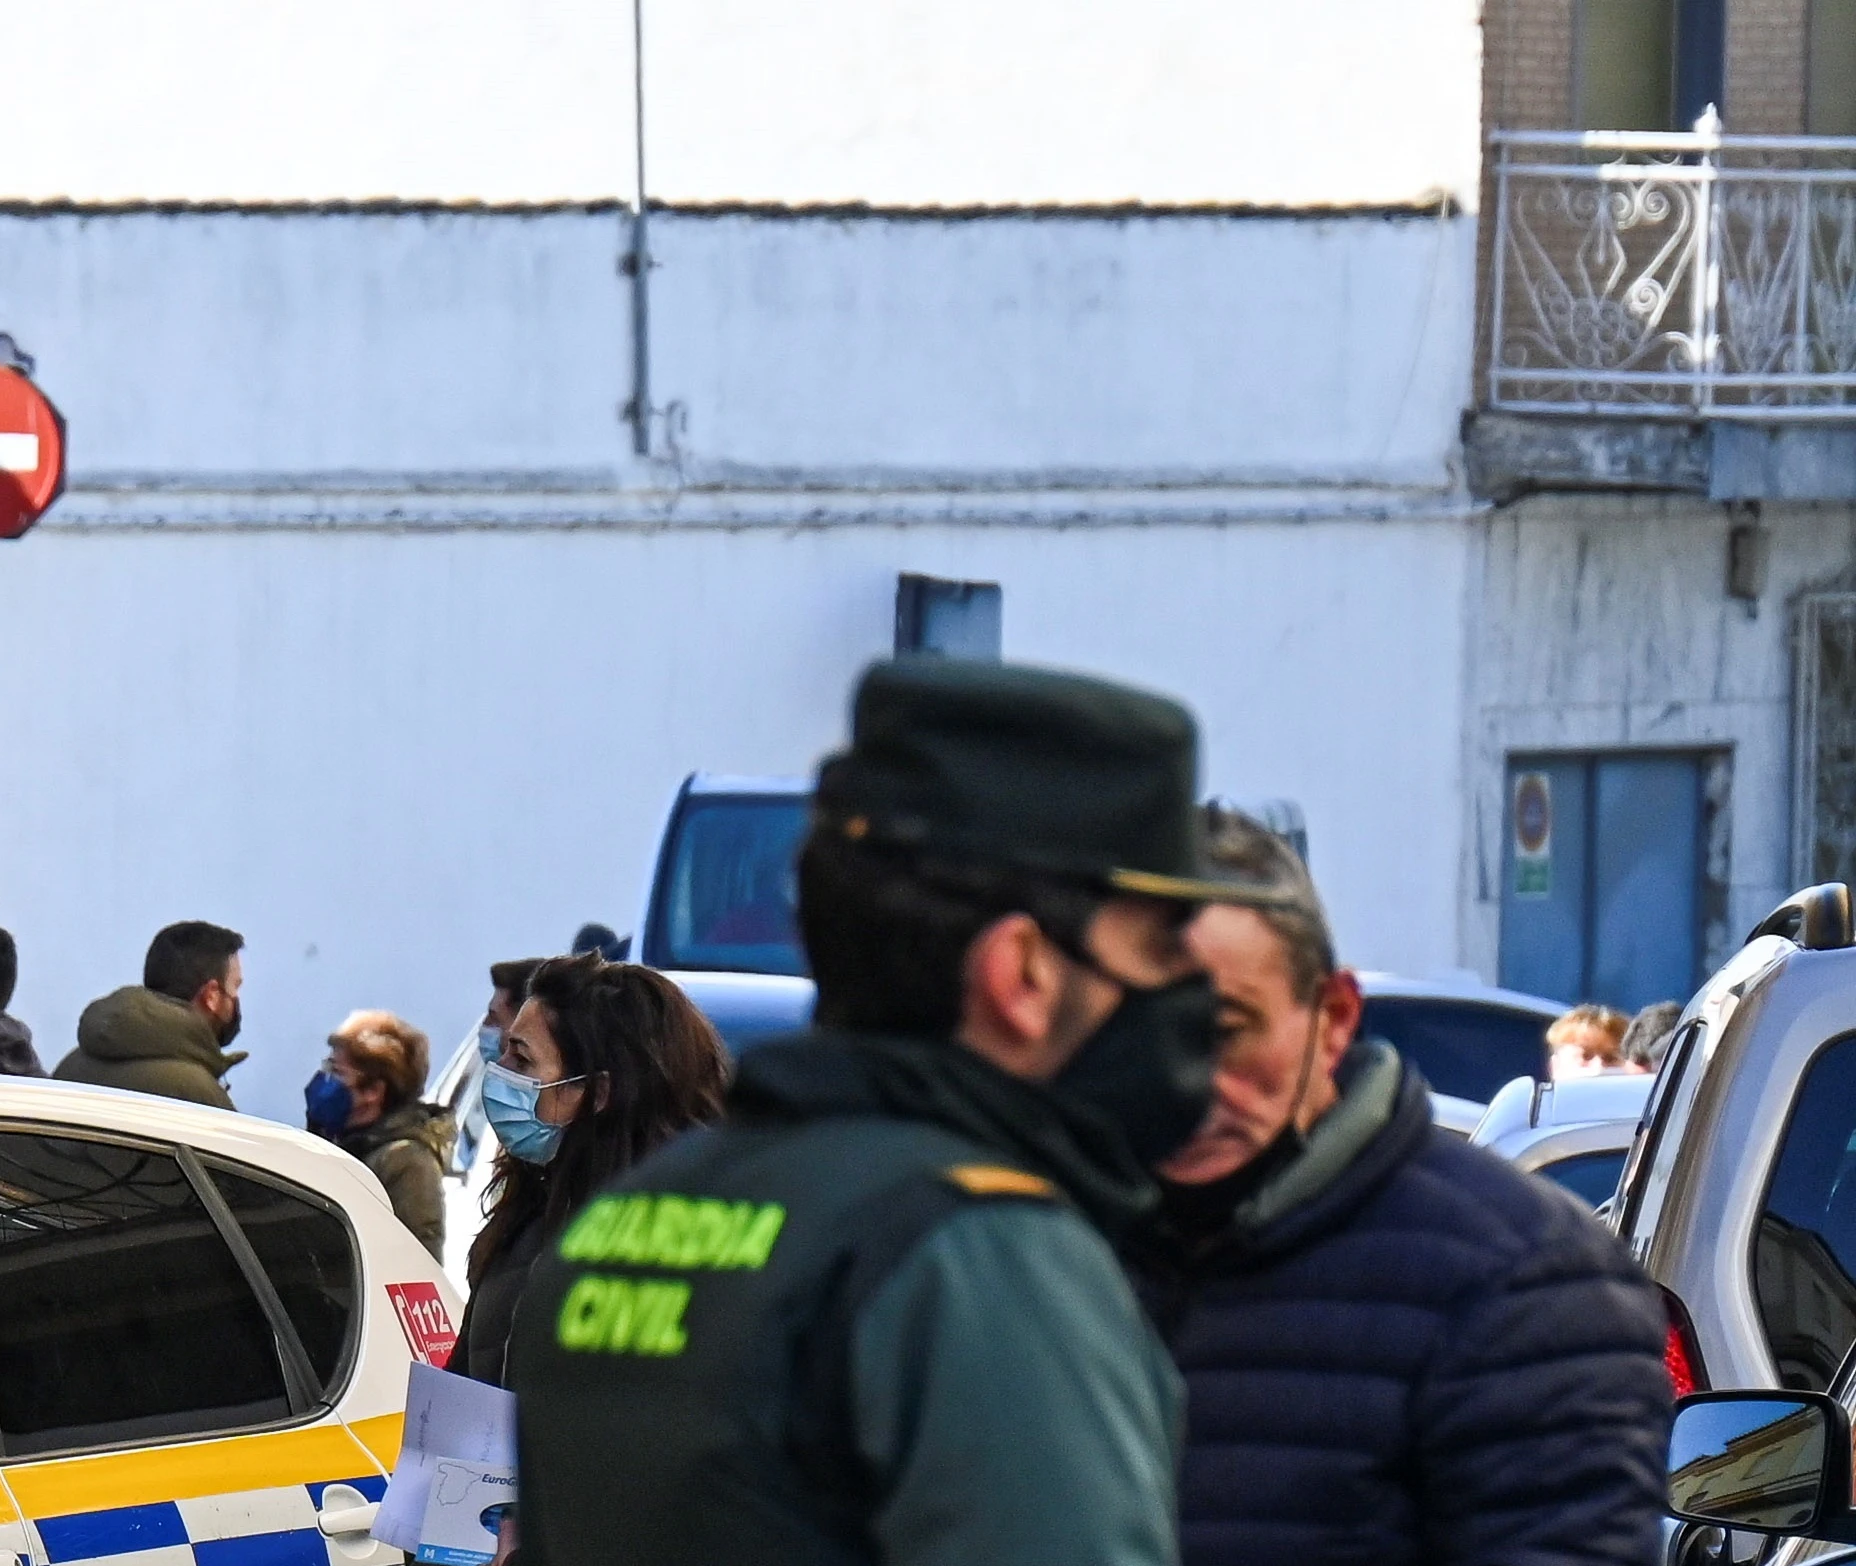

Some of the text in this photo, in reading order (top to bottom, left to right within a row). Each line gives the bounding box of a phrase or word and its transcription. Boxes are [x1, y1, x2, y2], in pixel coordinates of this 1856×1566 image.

[557, 1191, 786, 1271] GUARDIA
[412, 1298, 451, 1335] 112
[556, 1273, 692, 1356] CIVIL
